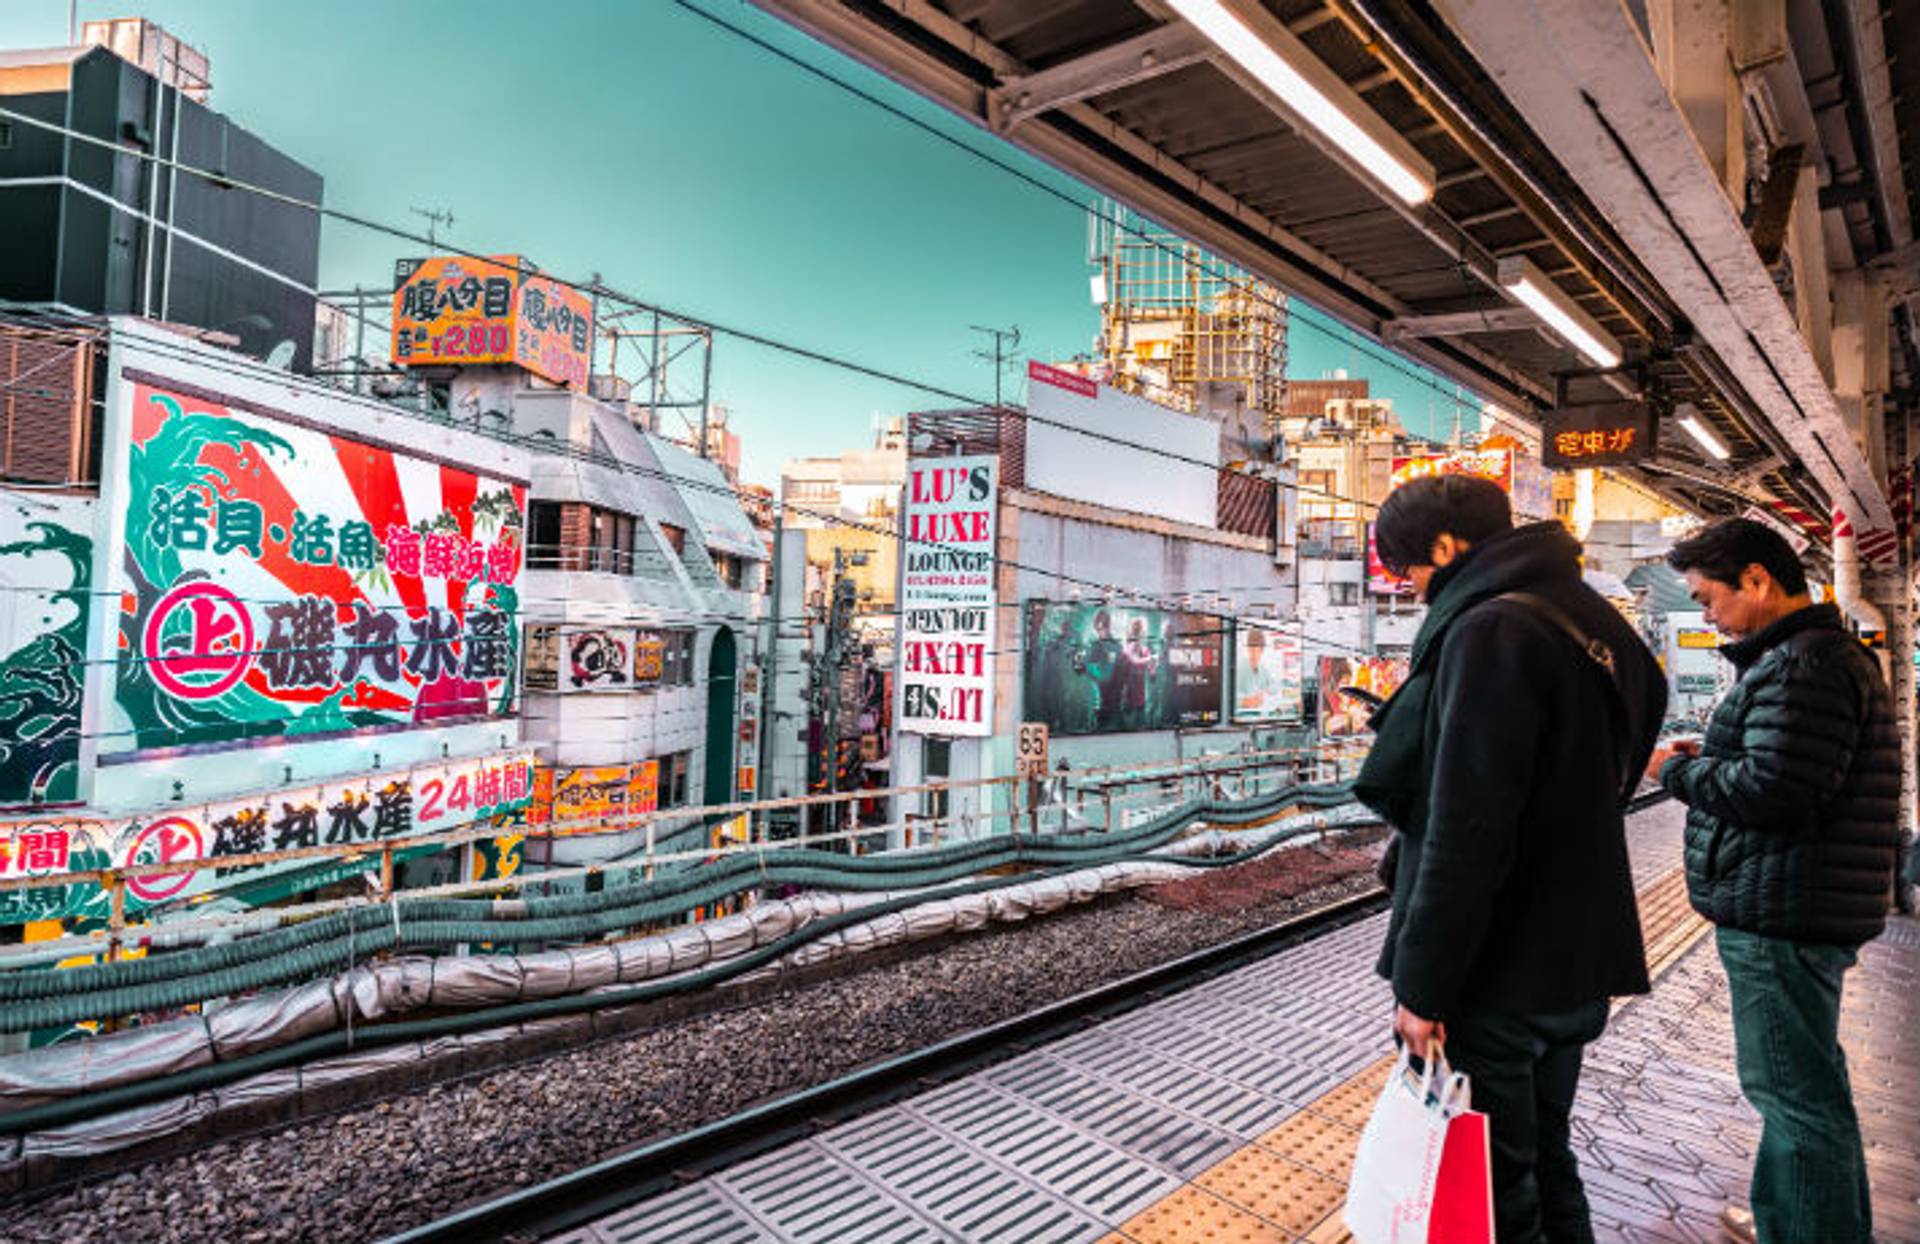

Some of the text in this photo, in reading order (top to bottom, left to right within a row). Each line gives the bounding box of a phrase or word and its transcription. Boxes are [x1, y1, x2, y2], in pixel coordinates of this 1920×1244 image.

[400, 276, 512, 321] 腹八分目
[910, 466, 990, 504] LU'S
[150, 487, 375, 571] 活貝・活魚
[909, 511, 990, 543] LUXE
[907, 551, 990, 572] LOUNGE
[258, 596, 509, 688] 磯丸水産
[904, 641, 985, 676] LUXE
[211, 781, 412, 878] 磯丸水産
[416, 761, 528, 822] 24時間
